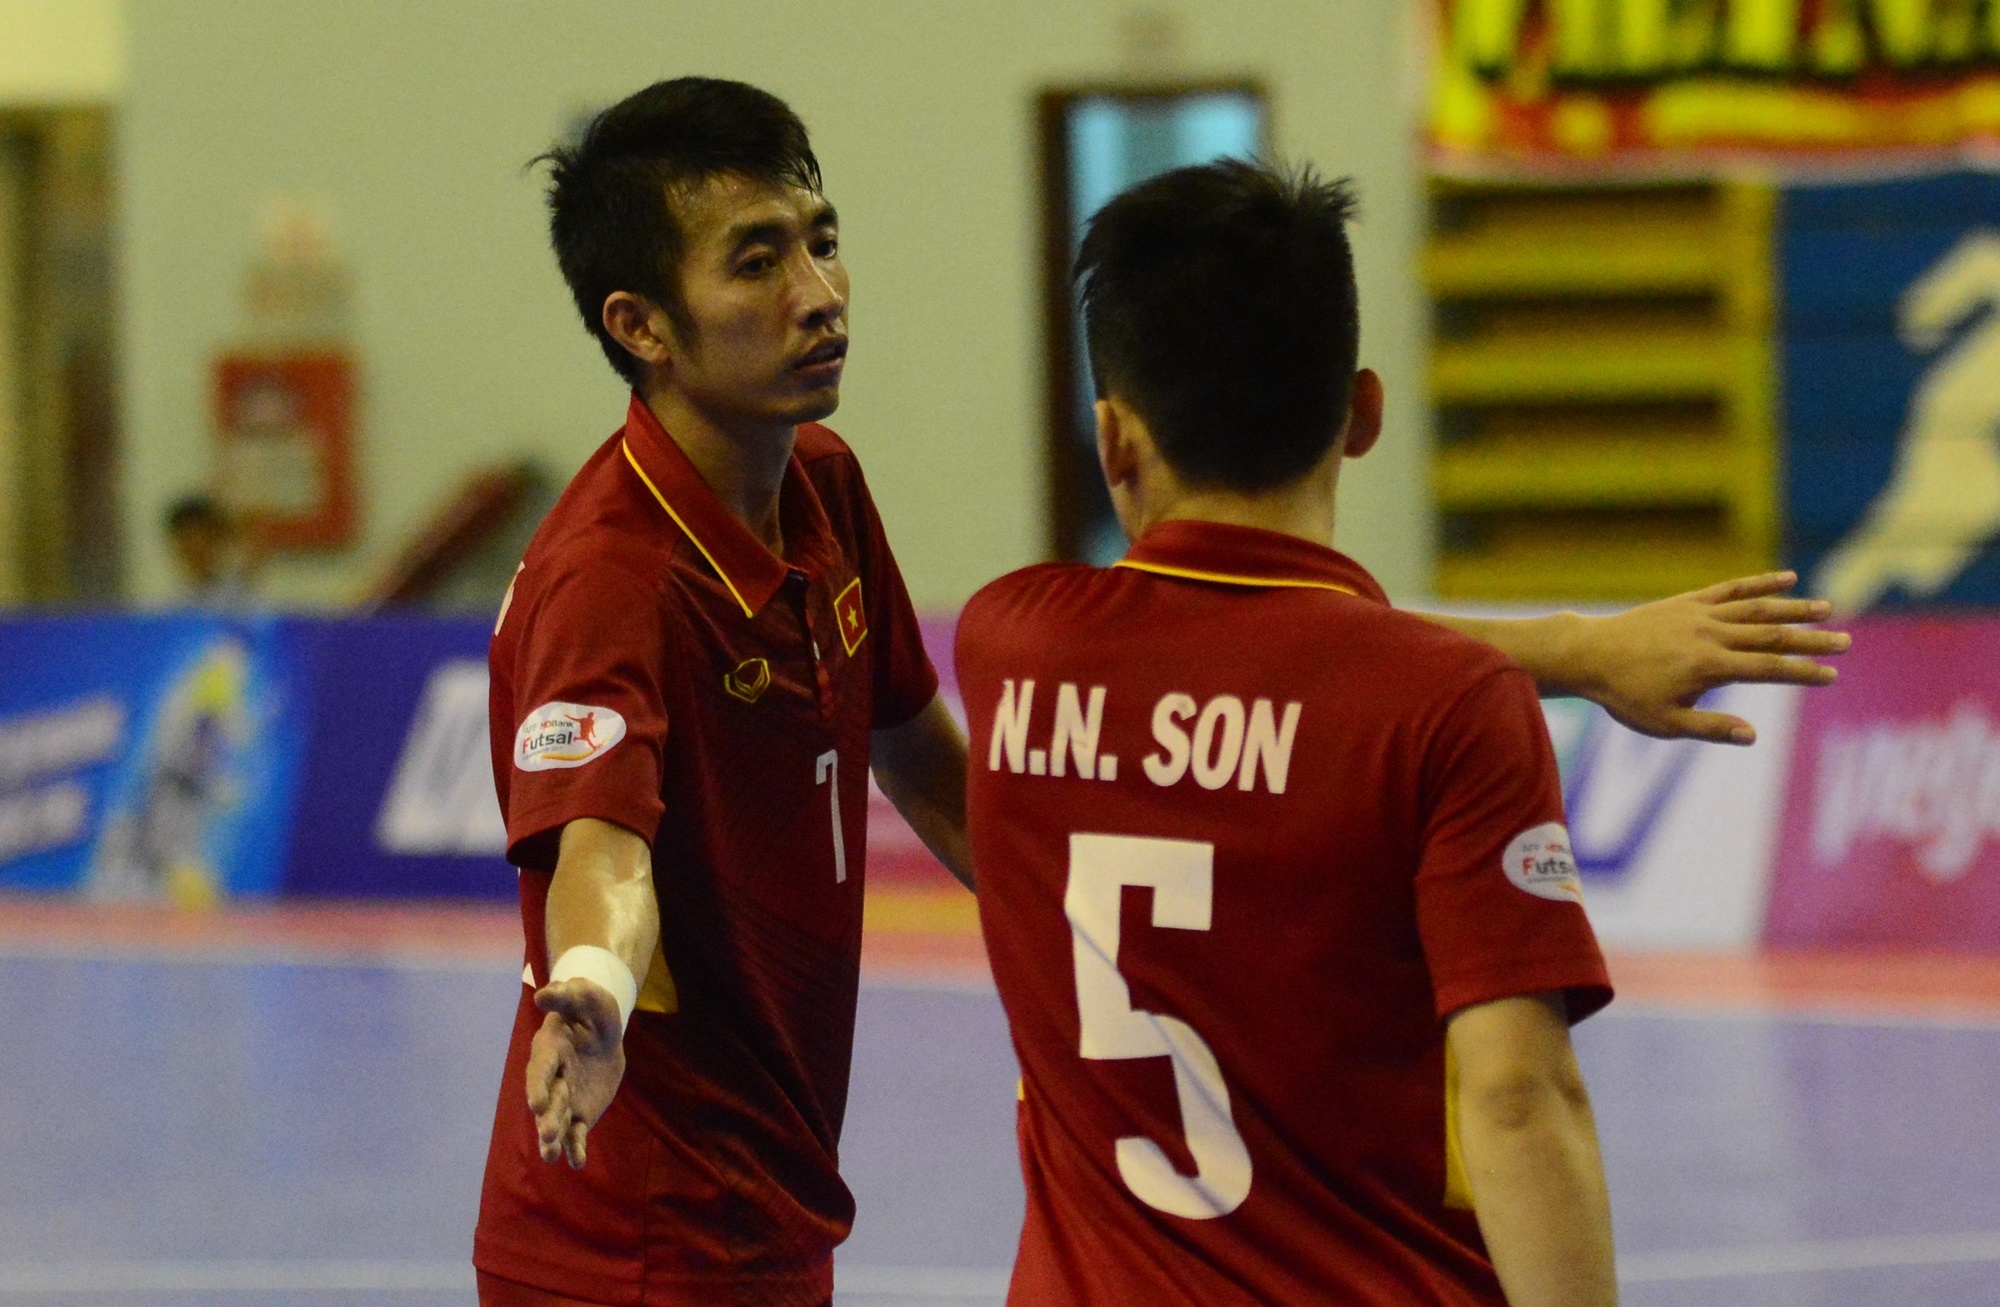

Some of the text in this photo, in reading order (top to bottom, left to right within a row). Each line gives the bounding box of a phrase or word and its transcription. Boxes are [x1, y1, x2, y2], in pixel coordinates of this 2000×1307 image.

[522, 731, 573, 754] Futsal
[989, 678, 1302, 794] N.N. SON
[816, 749, 846, 884] 7
[1522, 854, 1574, 876] Futs
[1064, 832, 1253, 1220] 5
